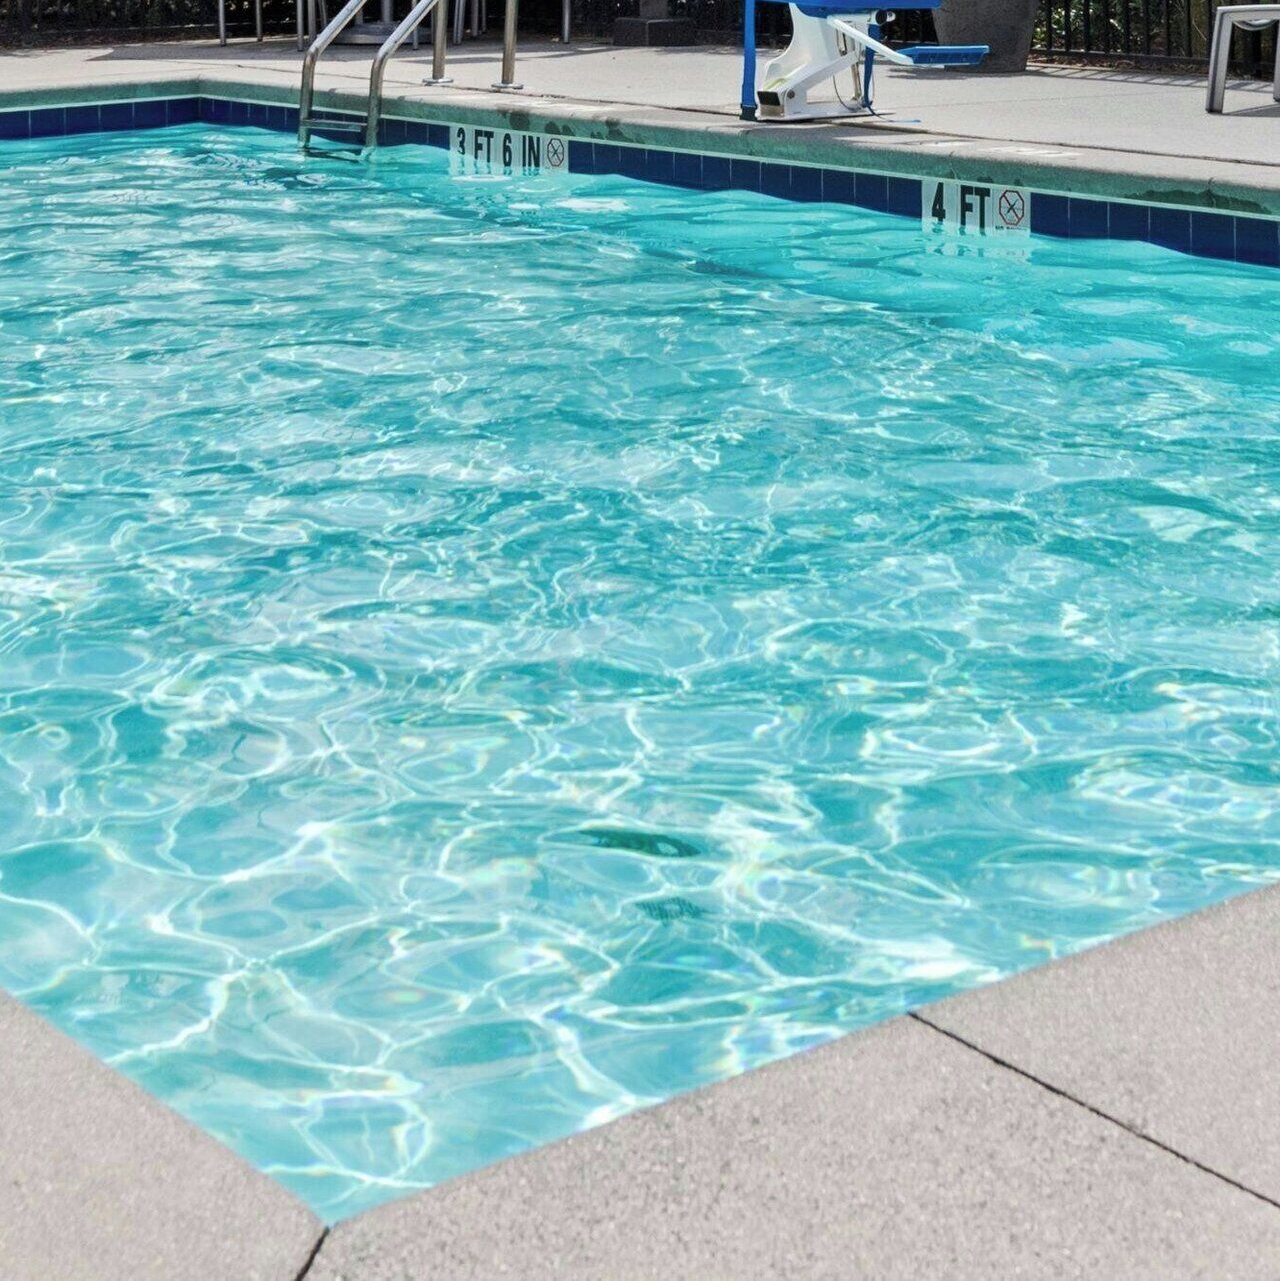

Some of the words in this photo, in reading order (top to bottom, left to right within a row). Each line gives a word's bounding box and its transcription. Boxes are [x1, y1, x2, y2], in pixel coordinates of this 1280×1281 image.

[474, 129, 494, 163] FT
[502, 132, 513, 167] 6
[522, 135, 541, 168] IN
[931, 182, 946, 223] 4
[960, 184, 991, 229] FT
